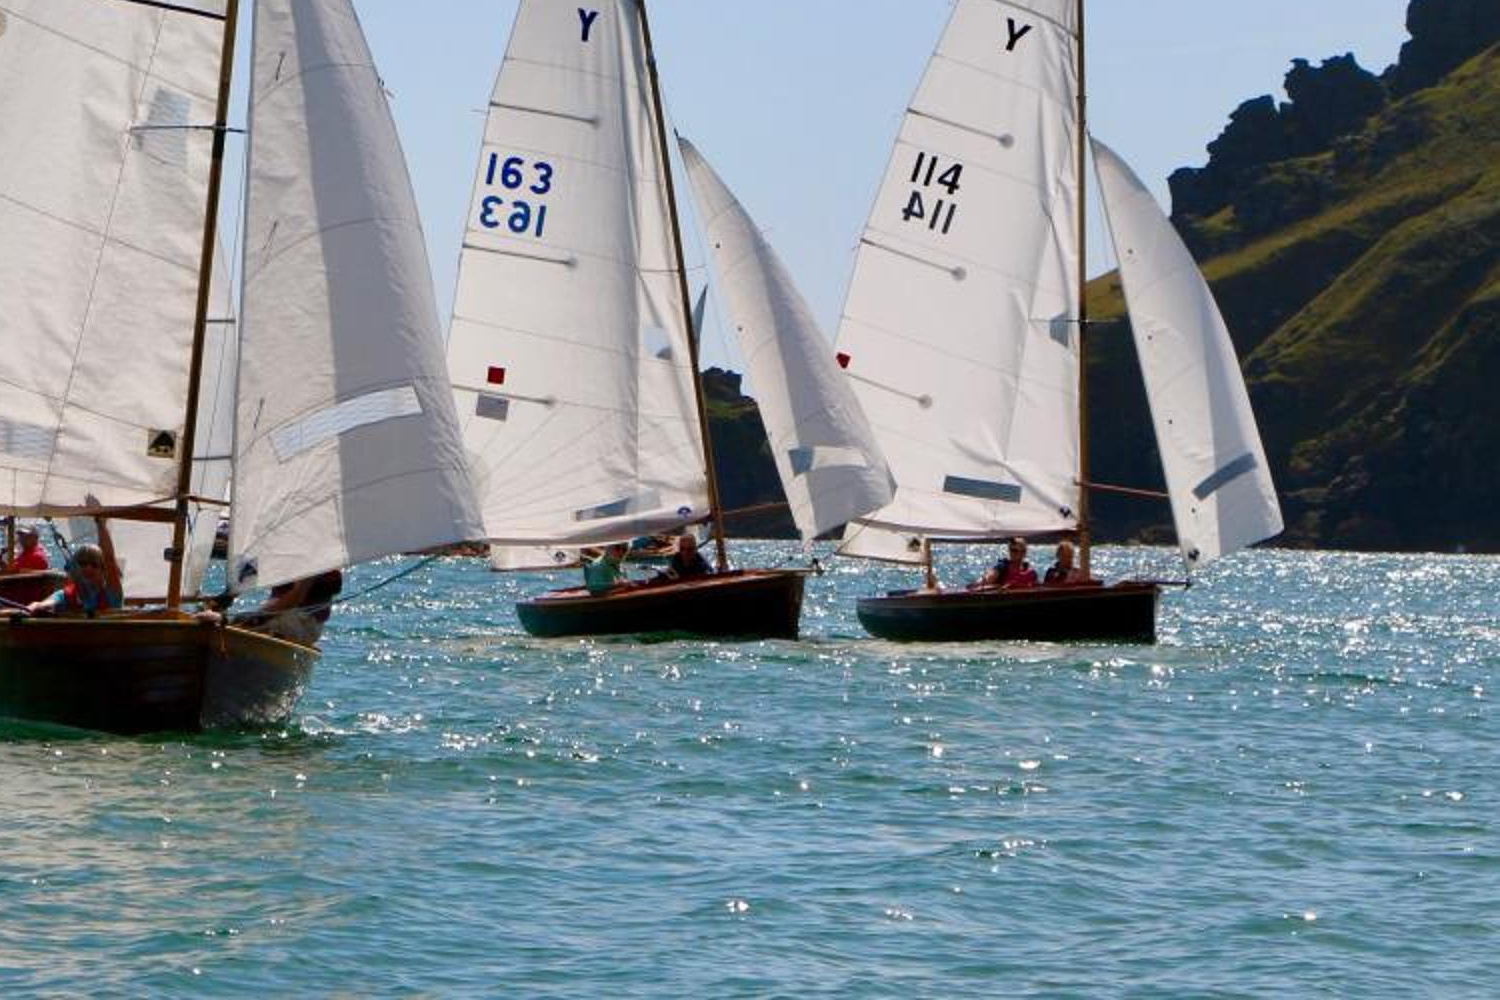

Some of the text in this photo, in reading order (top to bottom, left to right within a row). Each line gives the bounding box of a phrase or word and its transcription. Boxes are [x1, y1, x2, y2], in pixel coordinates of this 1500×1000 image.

[577, 7, 599, 43] Y
[1005, 17, 1032, 52] Y
[485, 152, 553, 195] 163
[910, 151, 963, 195] 114
